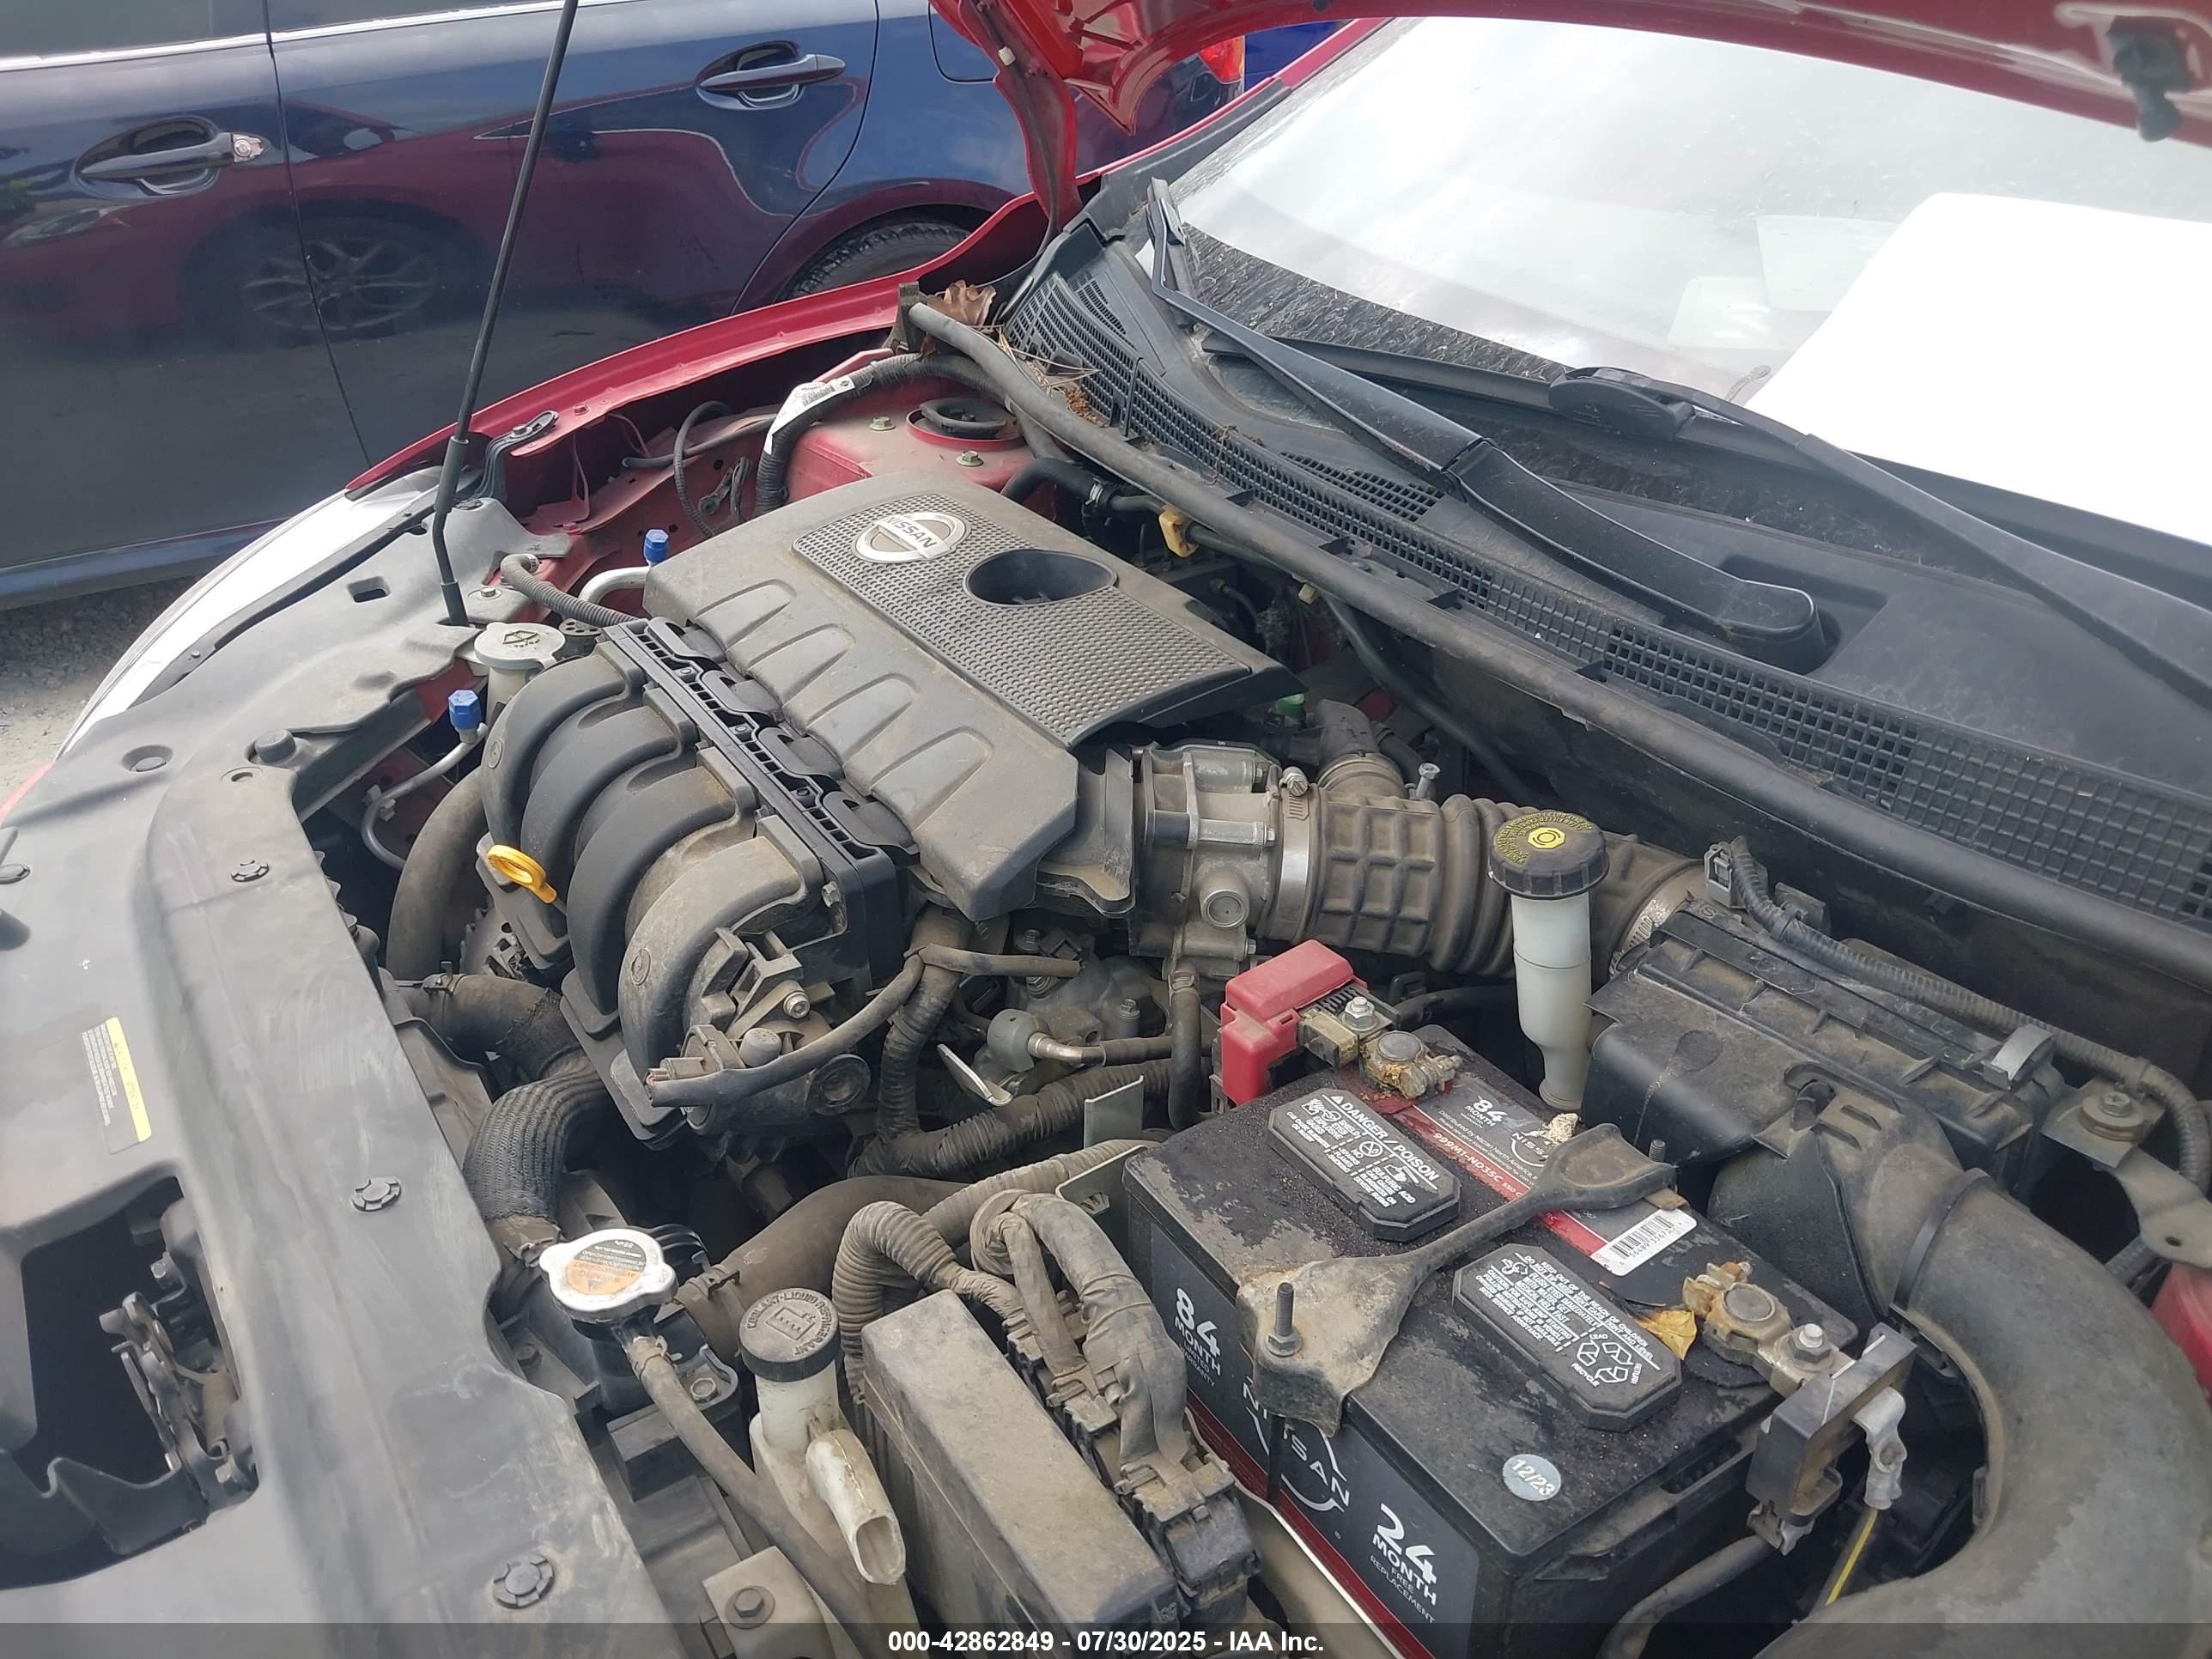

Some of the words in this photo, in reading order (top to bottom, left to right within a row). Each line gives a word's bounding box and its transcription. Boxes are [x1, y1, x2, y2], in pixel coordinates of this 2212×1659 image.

[886, 515, 938, 549] NISSAN
[1464, 1105, 1497, 1127] MONTH
[1473, 1099, 1509, 1122] 84
[1312, 1115, 1344, 1141] EXPLOSIVE
[1338, 1119, 1360, 1137] SHIELD
[1340, 1101, 1389, 1140] DANGER
[1394, 1144, 1440, 1182] POISON
[1350, 1149, 1364, 1159] NO
[1475, 1134, 1494, 1150] Nissan
[1492, 1147, 1510, 1161] North
[1370, 1166, 1402, 1192] SULFURIC
[1399, 1188, 1416, 1204] ACID
[1482, 1273, 1505, 1292] FOLLOW
[1508, 1287, 1522, 1297] FOR
[1522, 1276, 1541, 1291] WITH
[1556, 1303, 1572, 1315] GET
[1515, 1279, 1541, 1300] MEDICAL
[1537, 1297, 1557, 1313] HELP
[1553, 1310, 1571, 1324] FAST
[1524, 1255, 1536, 1264] DO
[1533, 1262, 1548, 1274] NOT
[1621, 1333, 1637, 1346] AND
[1634, 1344, 1656, 1360] LEVEL
[1528, 1272, 1550, 1288] FLUSH
[1547, 1285, 1565, 1299] EYES
[1560, 1297, 1600, 1328] IMMEDIATELY
[1540, 1261, 1558, 1274] KEEP
[1555, 1273, 1570, 1285] OUT
[1567, 1283, 1579, 1291] OF
[1577, 1291, 1592, 1302] THE
[1608, 1316, 1620, 1324] OF
[1618, 1322, 1649, 1347] CHILDREN
[1176, 1287, 1221, 1357] 84
[1522, 1315, 1535, 1326] NOT
[1175, 1316, 1221, 1376] MONTH
[1183, 1340, 1210, 1373] LIMITED
[1571, 1363, 1601, 1388] RECYCLE
[1631, 1363, 1643, 1385] RETURN
[1511, 1459, 1555, 1497] 12/23
[1376, 1503, 1437, 1585] 24
[1372, 1534, 1437, 1607] MONTH
[1390, 1565, 1415, 1594] FREE
[1370, 1554, 1436, 1624] REPLACEMENT
